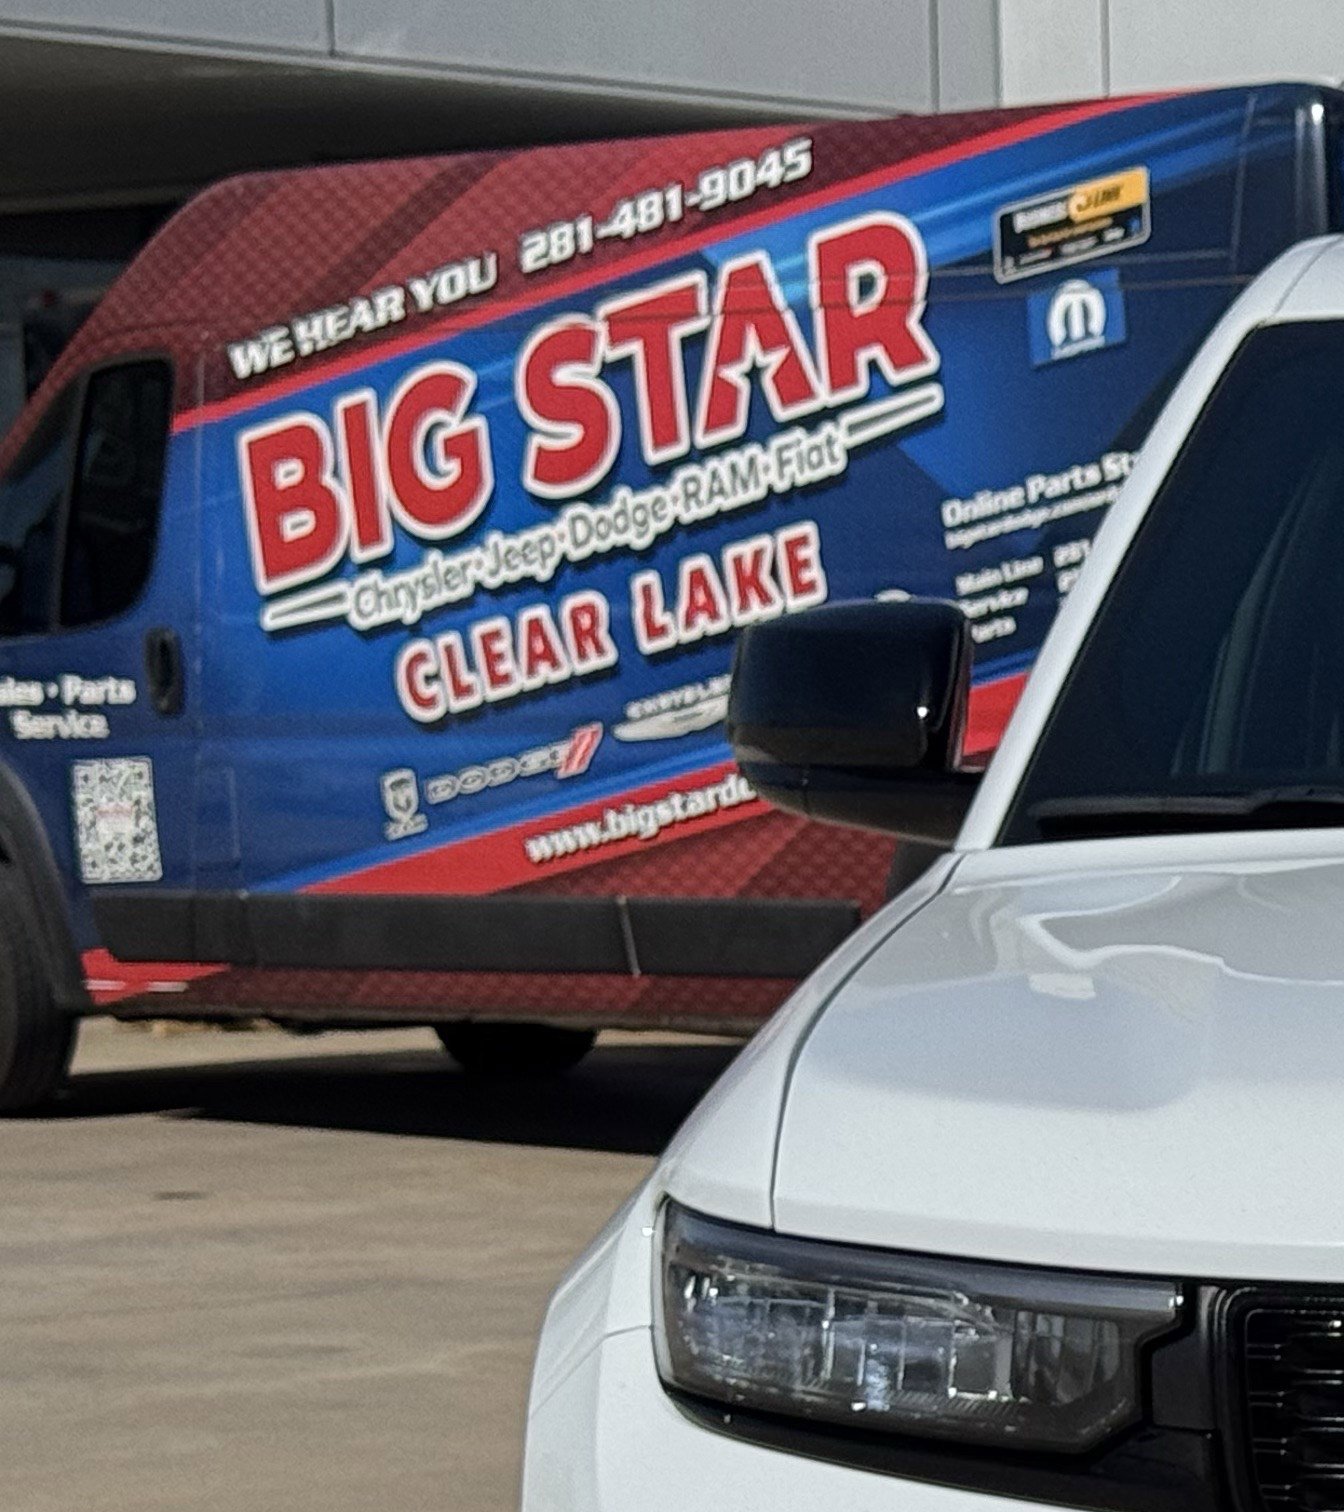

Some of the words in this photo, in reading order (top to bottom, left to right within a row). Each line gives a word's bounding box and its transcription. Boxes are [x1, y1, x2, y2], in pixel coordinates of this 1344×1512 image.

[228, 325, 296, 379] WE
[291, 284, 407, 358] HEAR
[409, 251, 498, 312] YOU
[519, 137, 815, 274] 281-481-9045
[237, 361, 494, 595] BIG
[517, 211, 942, 498] STAR
[940, 484, 1026, 528] Online
[1025, 464, 1102, 504] Parts
[397, 590, 618, 722] CLEAR
[631, 520, 829, 654] LAKE
